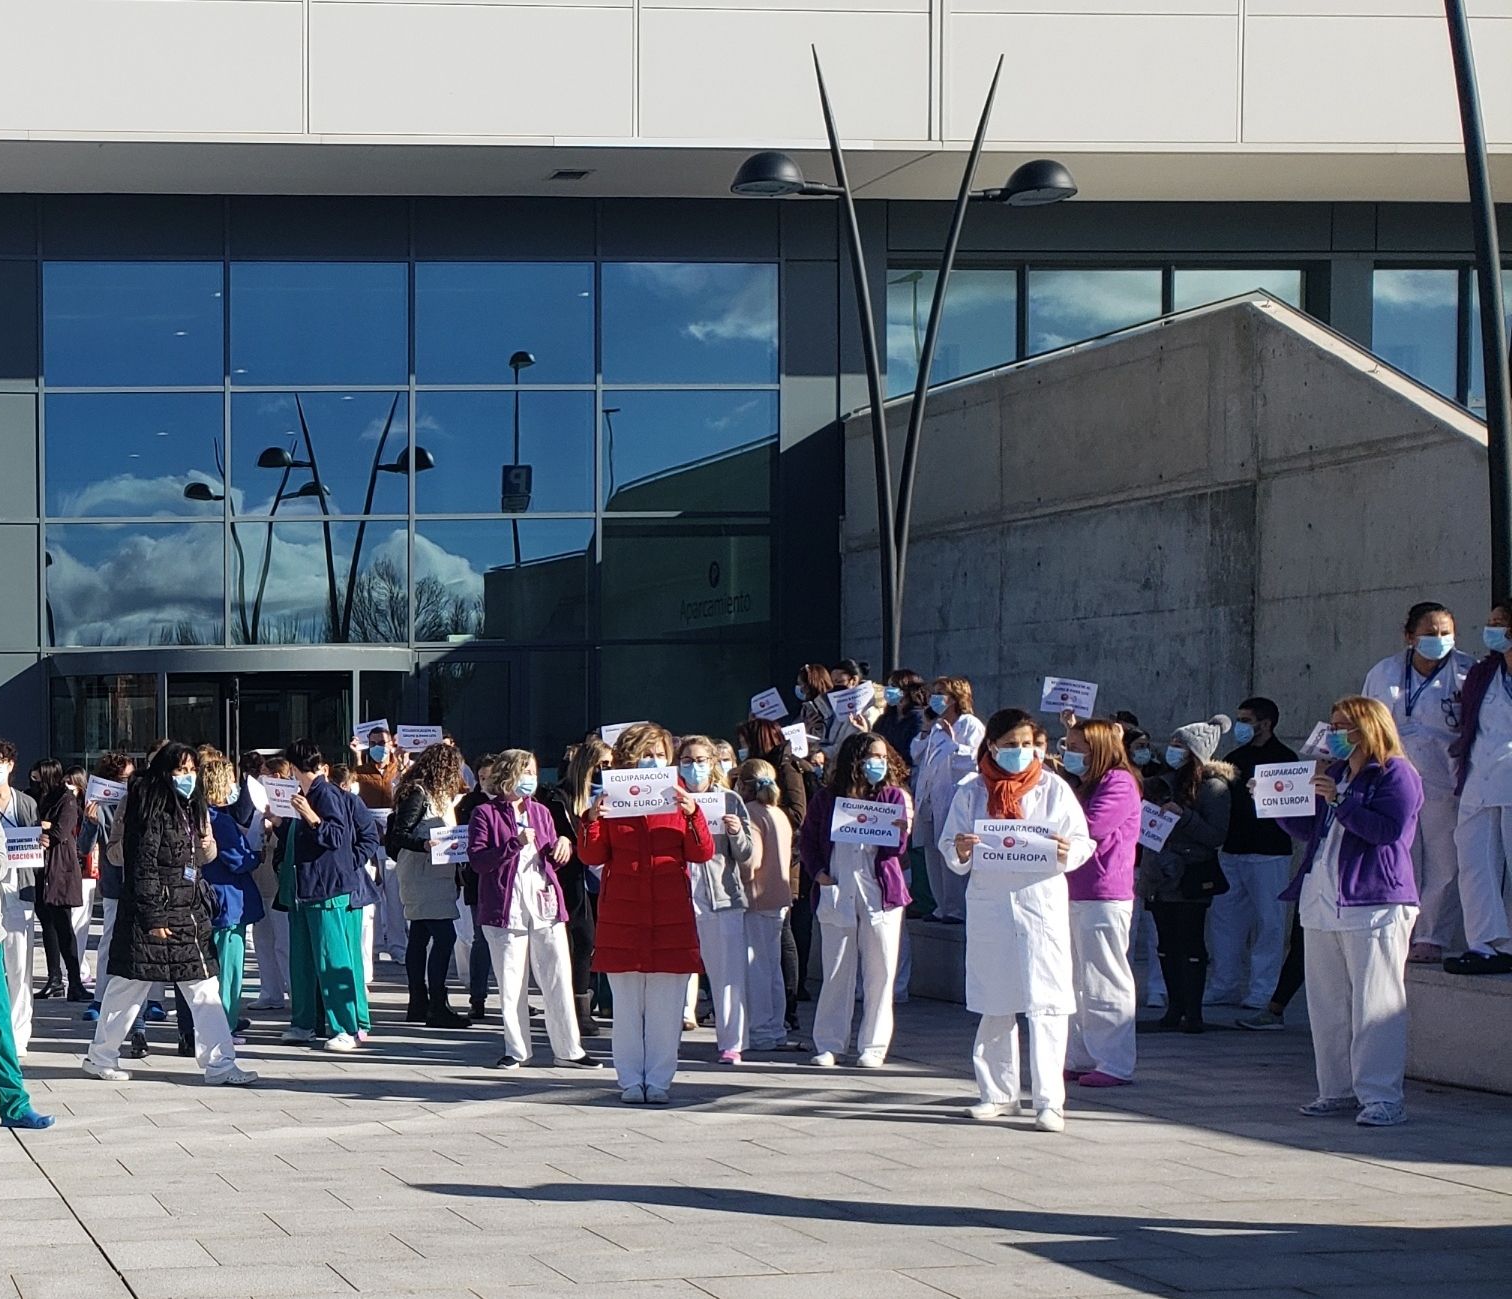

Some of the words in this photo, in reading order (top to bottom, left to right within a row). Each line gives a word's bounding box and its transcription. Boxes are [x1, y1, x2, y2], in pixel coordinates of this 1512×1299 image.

[1261, 767, 1308, 777] EQUIPARACIÓN
[610, 772, 669, 782] EQUIPARACIÓN
[634, 798, 669, 807] EUROPA
[1280, 796, 1309, 804] EUROPA
[842, 802, 896, 815] EQUIPARACIÓN
[859, 828, 892, 836] EUROPA
[984, 824, 1048, 834] EQUIPARACIÓN
[1007, 853, 1048, 862] EUROPA
